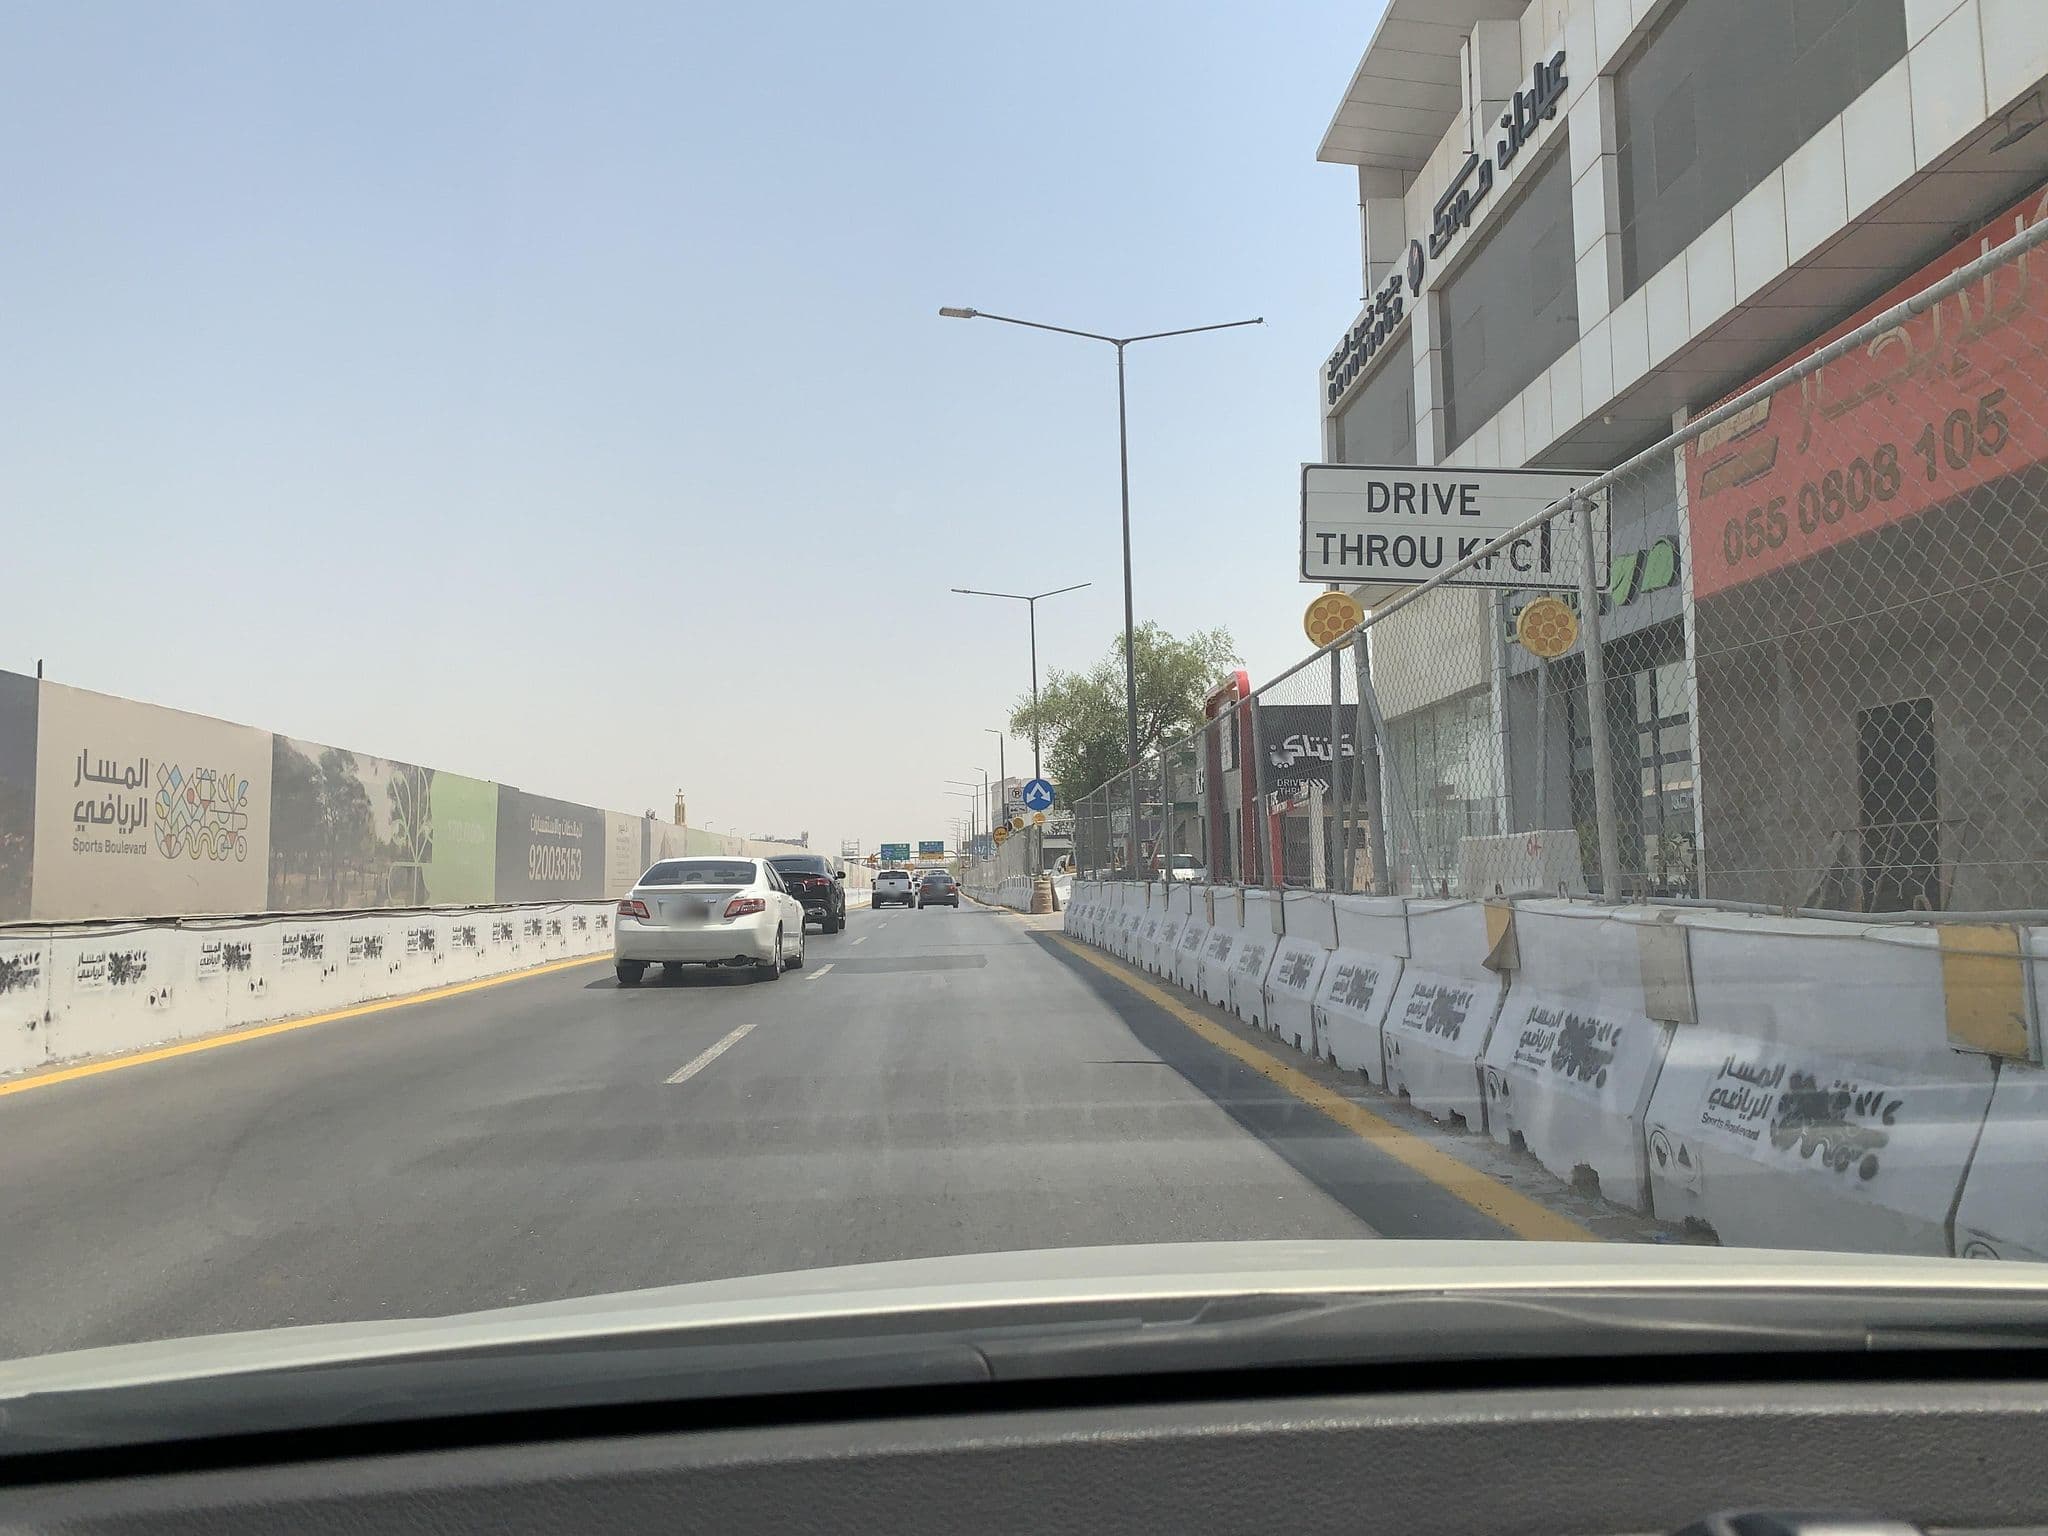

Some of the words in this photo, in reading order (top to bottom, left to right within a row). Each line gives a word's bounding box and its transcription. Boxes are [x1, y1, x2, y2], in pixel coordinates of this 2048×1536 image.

[1724, 497, 1788, 566] 055
[1798, 443, 1900, 534] 0808
[1916, 388, 2008, 482] 105
[1368, 482, 1480, 516] DRIVE
[1316, 533, 1443, 568] THROU
[74, 749, 148, 790] المسار
[73, 793, 148, 834] الرياضي
[73, 838, 103, 855] Sports
[104, 839, 147, 855] Boulevard
[529, 844, 582, 881] 920035153
[1717, 1053, 1786, 1089] المسار
[1701, 1112, 1724, 1129] Sports
[1708, 1087, 1773, 1121] الرياضي
